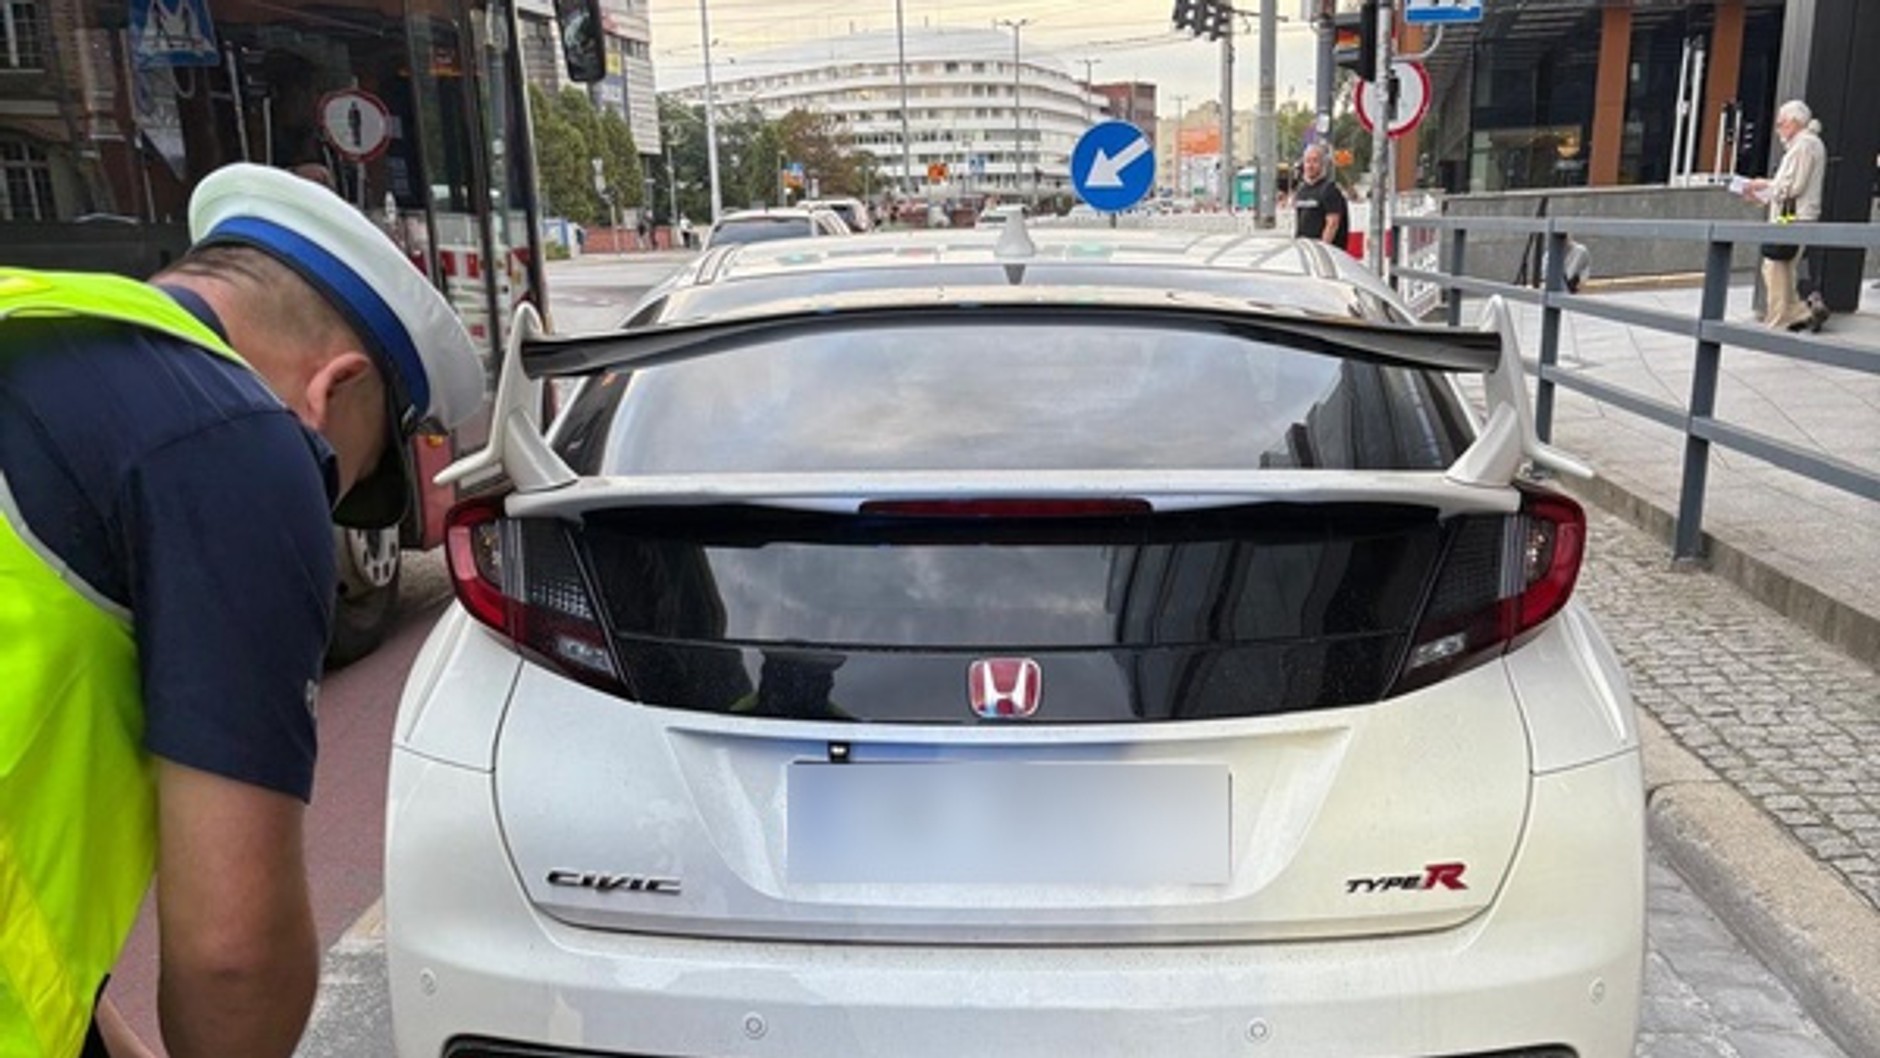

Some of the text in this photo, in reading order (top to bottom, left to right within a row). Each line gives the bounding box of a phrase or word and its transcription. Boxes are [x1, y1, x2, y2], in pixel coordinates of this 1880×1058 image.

[547, 869, 681, 895] CIVIC
[1346, 862, 1468, 893] TYPE R
